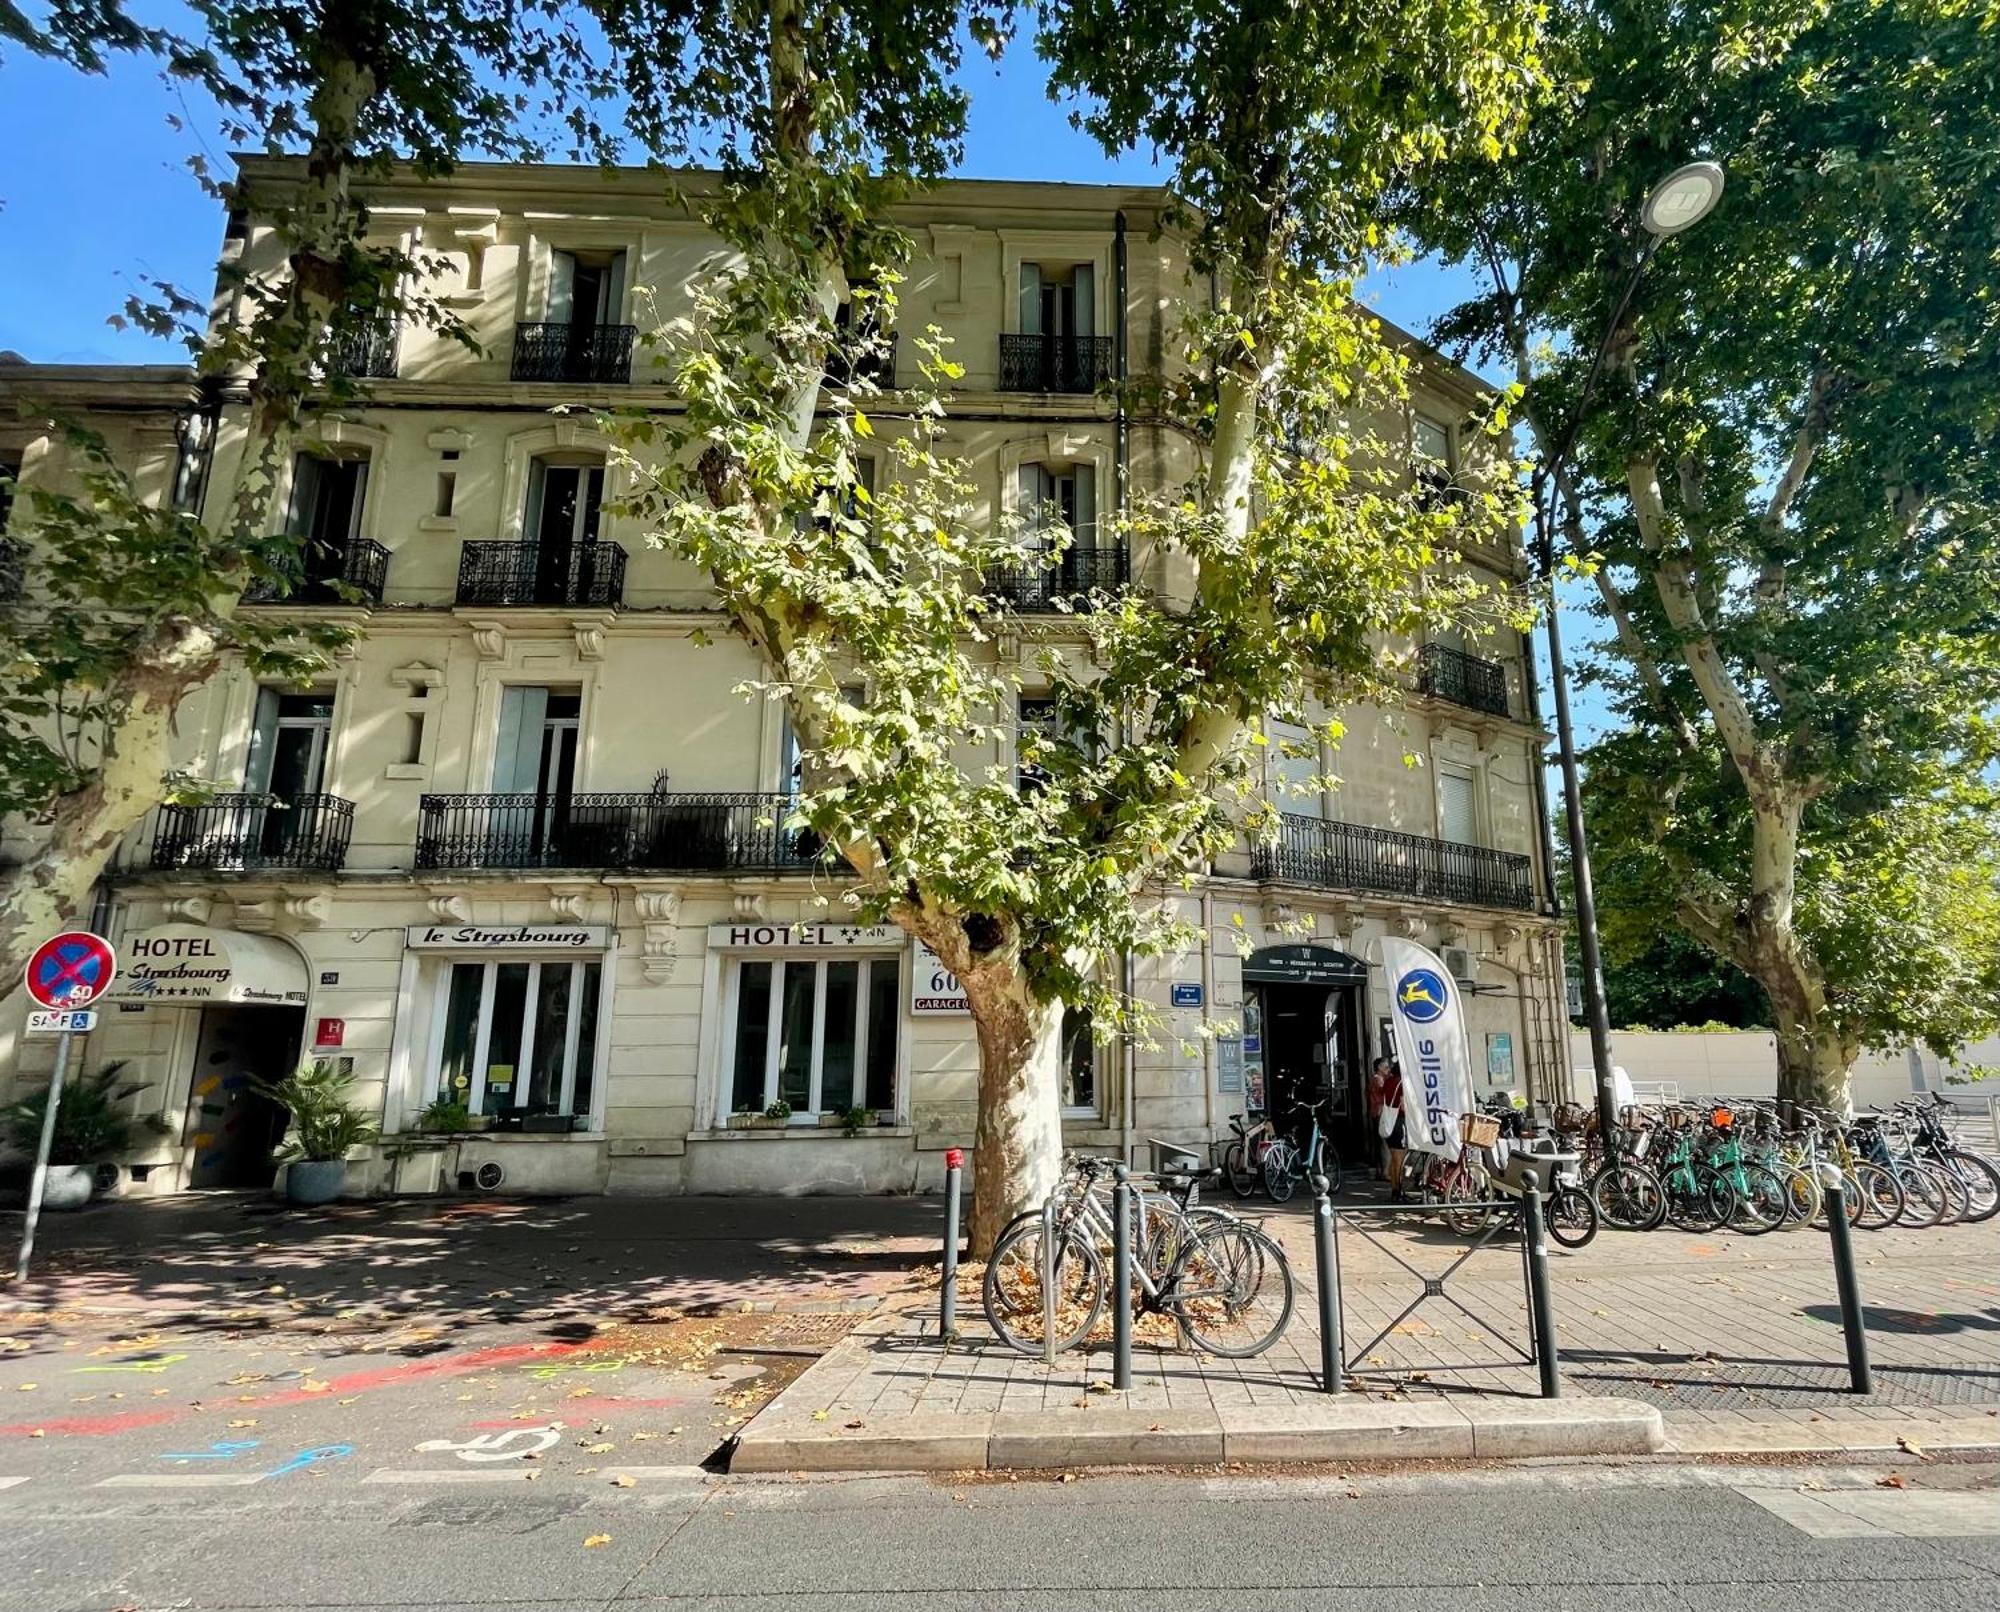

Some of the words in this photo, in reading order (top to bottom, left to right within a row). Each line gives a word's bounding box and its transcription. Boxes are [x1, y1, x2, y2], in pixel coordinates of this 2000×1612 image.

[423, 927, 444, 943] le
[451, 927, 591, 946] Strasbourg
[730, 927, 834, 946] HOTEL
[131, 938, 217, 957] HOTEL
[127, 961, 232, 983] Strasbourg
[192, 986, 212, 997] NN
[916, 998, 961, 1010] GARAGE
[328, 1021, 341, 1034] H
